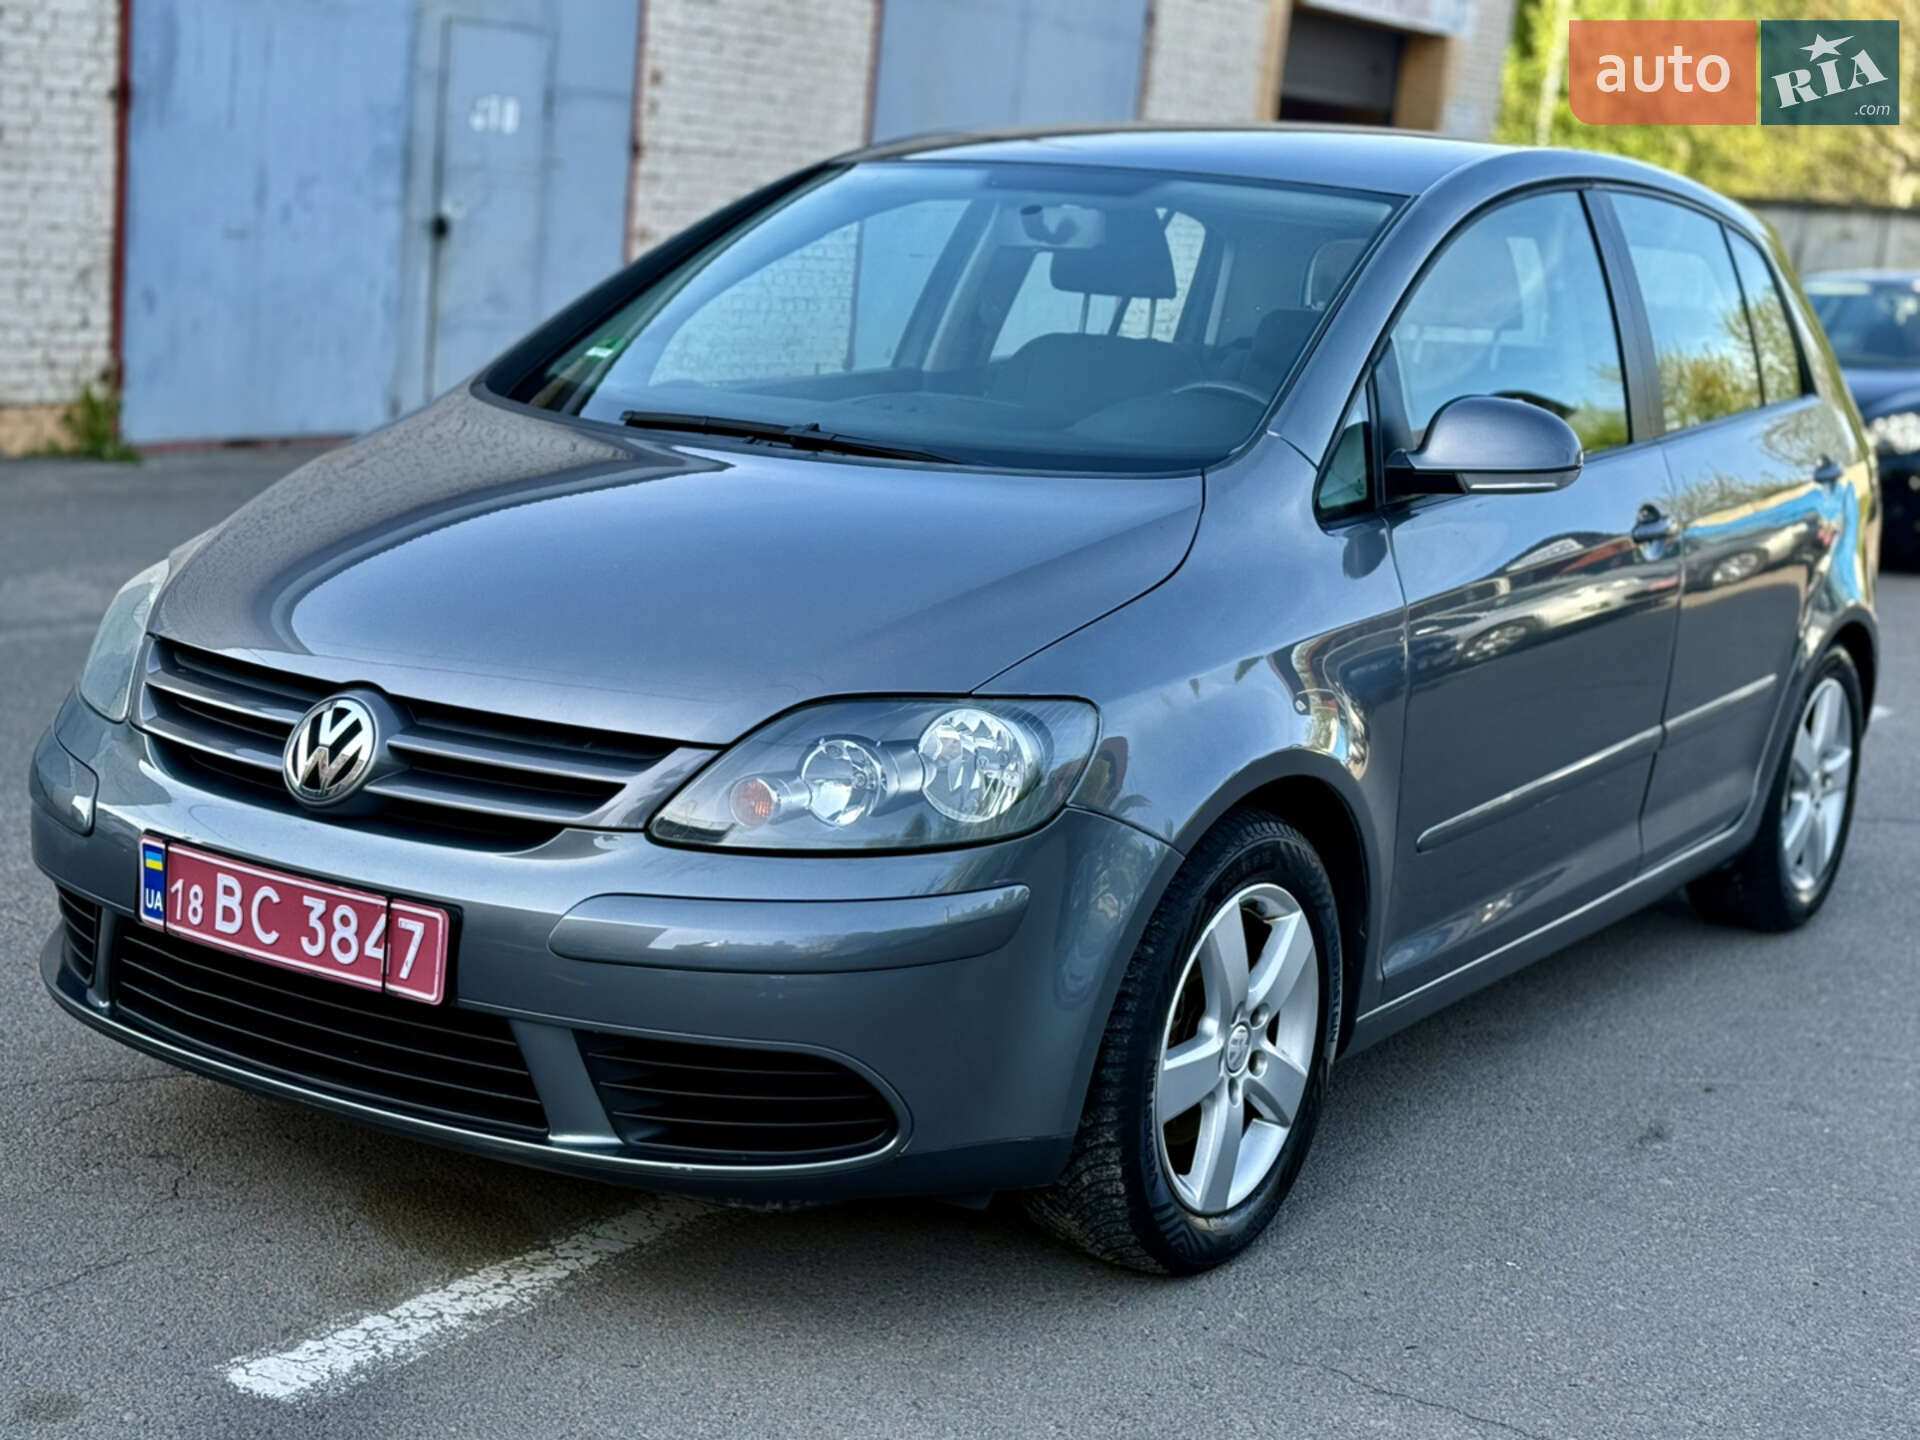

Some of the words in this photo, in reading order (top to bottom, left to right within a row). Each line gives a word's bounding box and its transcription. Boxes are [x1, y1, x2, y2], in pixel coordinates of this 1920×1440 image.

[145, 889, 163, 912] UA
[170, 878, 204, 926] 18
[214, 872, 281, 945] BC
[300, 895, 425, 980] 3847
